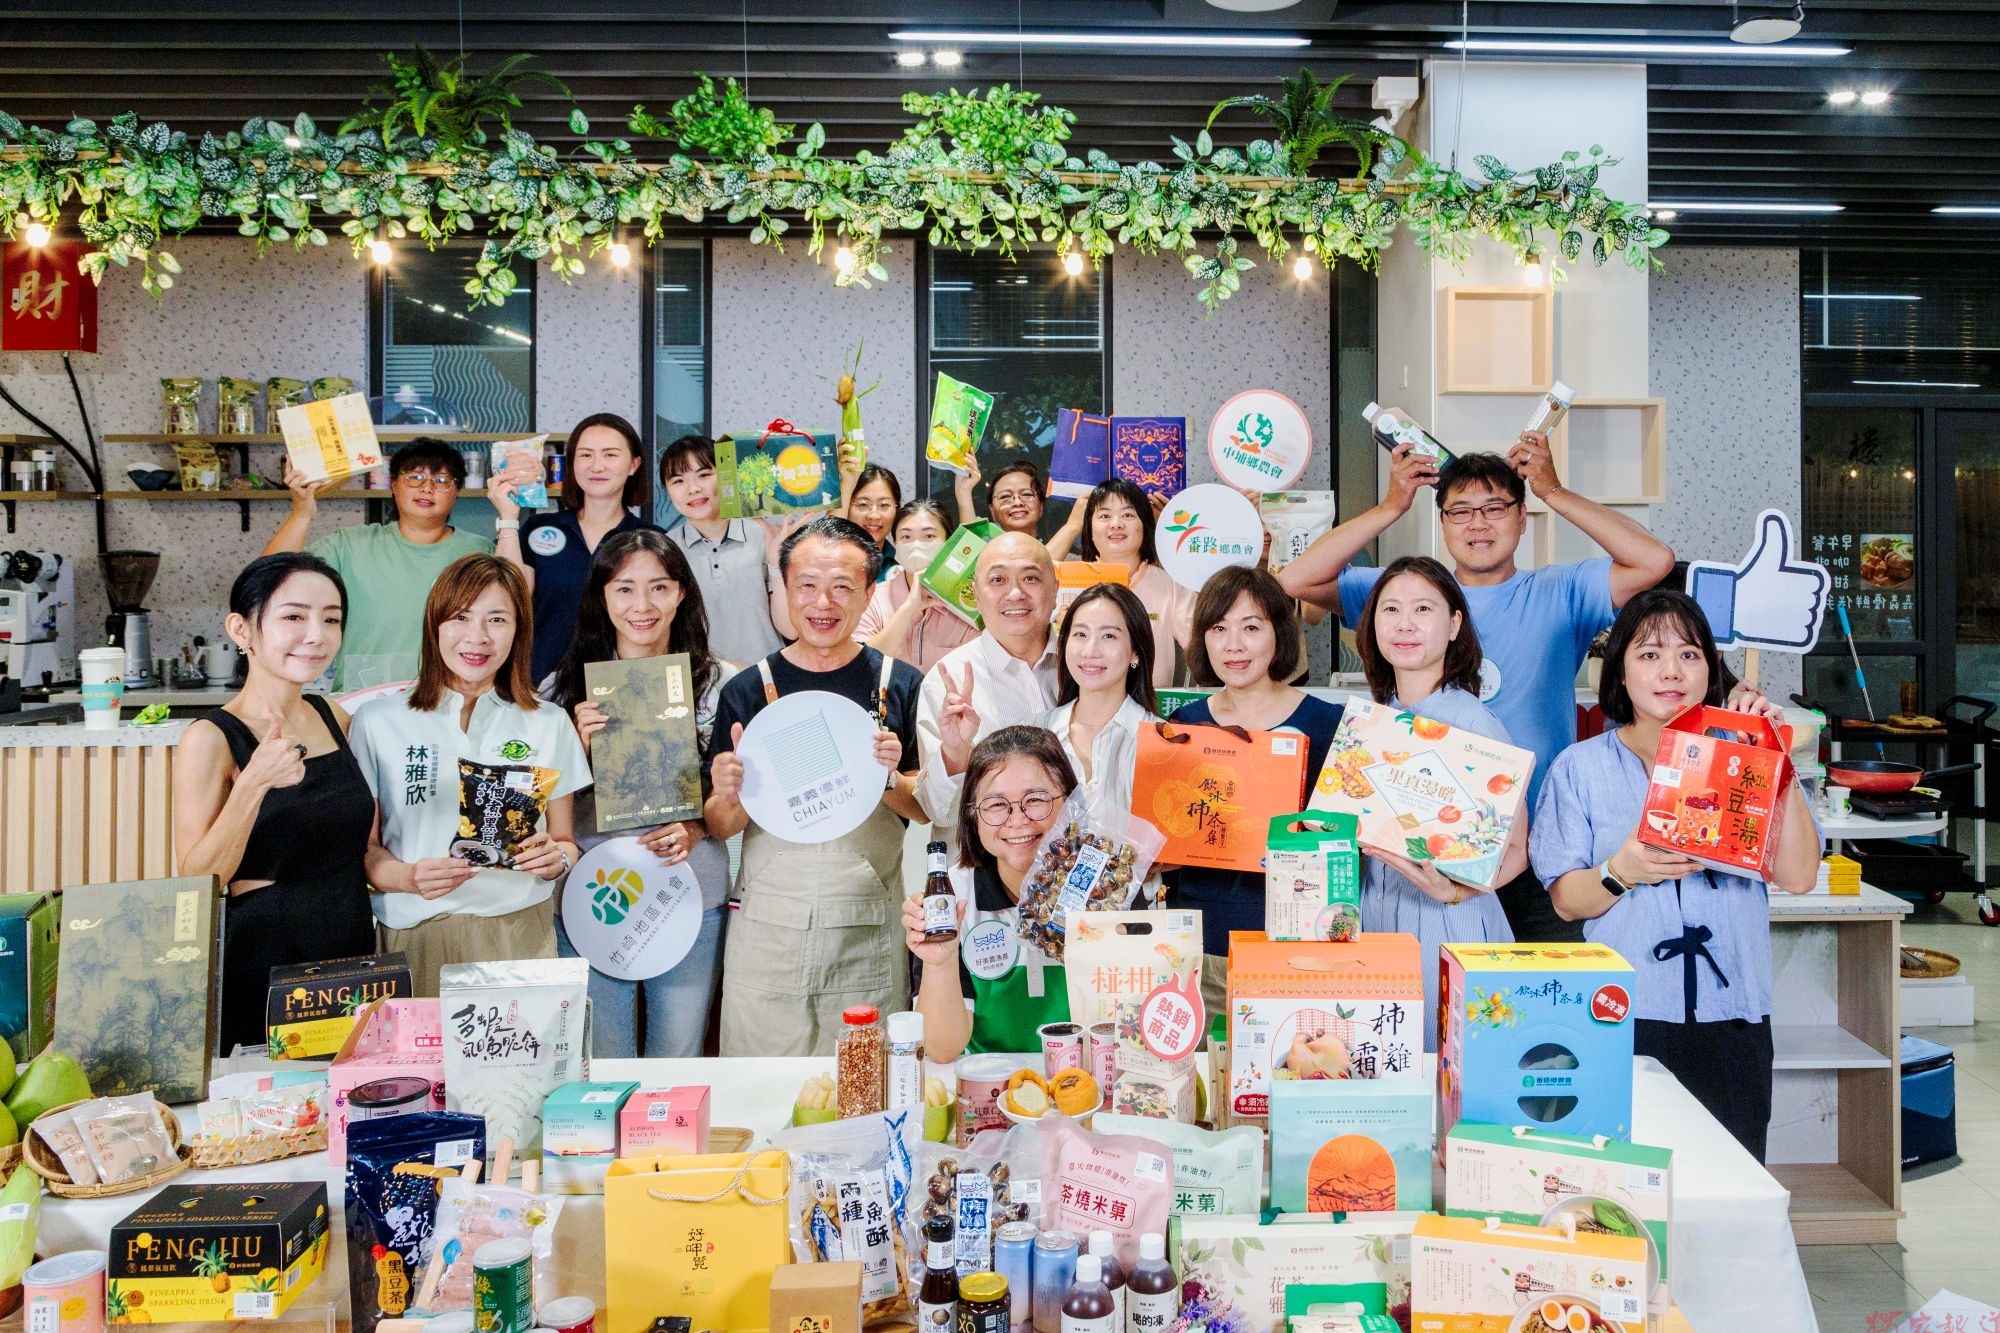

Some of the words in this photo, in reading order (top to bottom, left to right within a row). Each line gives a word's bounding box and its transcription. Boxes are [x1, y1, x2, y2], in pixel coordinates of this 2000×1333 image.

[13, 269, 70, 322] 財
[1222, 446, 1284, 479] 中埔鄉農會
[1188, 536, 1254, 555] 番路鄉農會
[404, 744, 429, 806] 林雅欣
[786, 774, 852, 809] 嘉義優鮮
[792, 787, 857, 823] CHIAYUM
[608, 873, 684, 966] 竹崎地區農會
[1090, 966, 1156, 994] 椪柑
[1154, 996, 1193, 1031] 熱銷
[1147, 1016, 1183, 1051] 商品
[1059, 1183, 1129, 1222] 茶燒米菓
[149, 1288, 197, 1298] PINEAPPLE
[387, 1258, 404, 1306] 黑豆茶
[149, 1298, 198, 1308] SPARKLING
[199, 1297, 227, 1306] DRINK
[1132, 1311, 1165, 1326] 喝的凍
